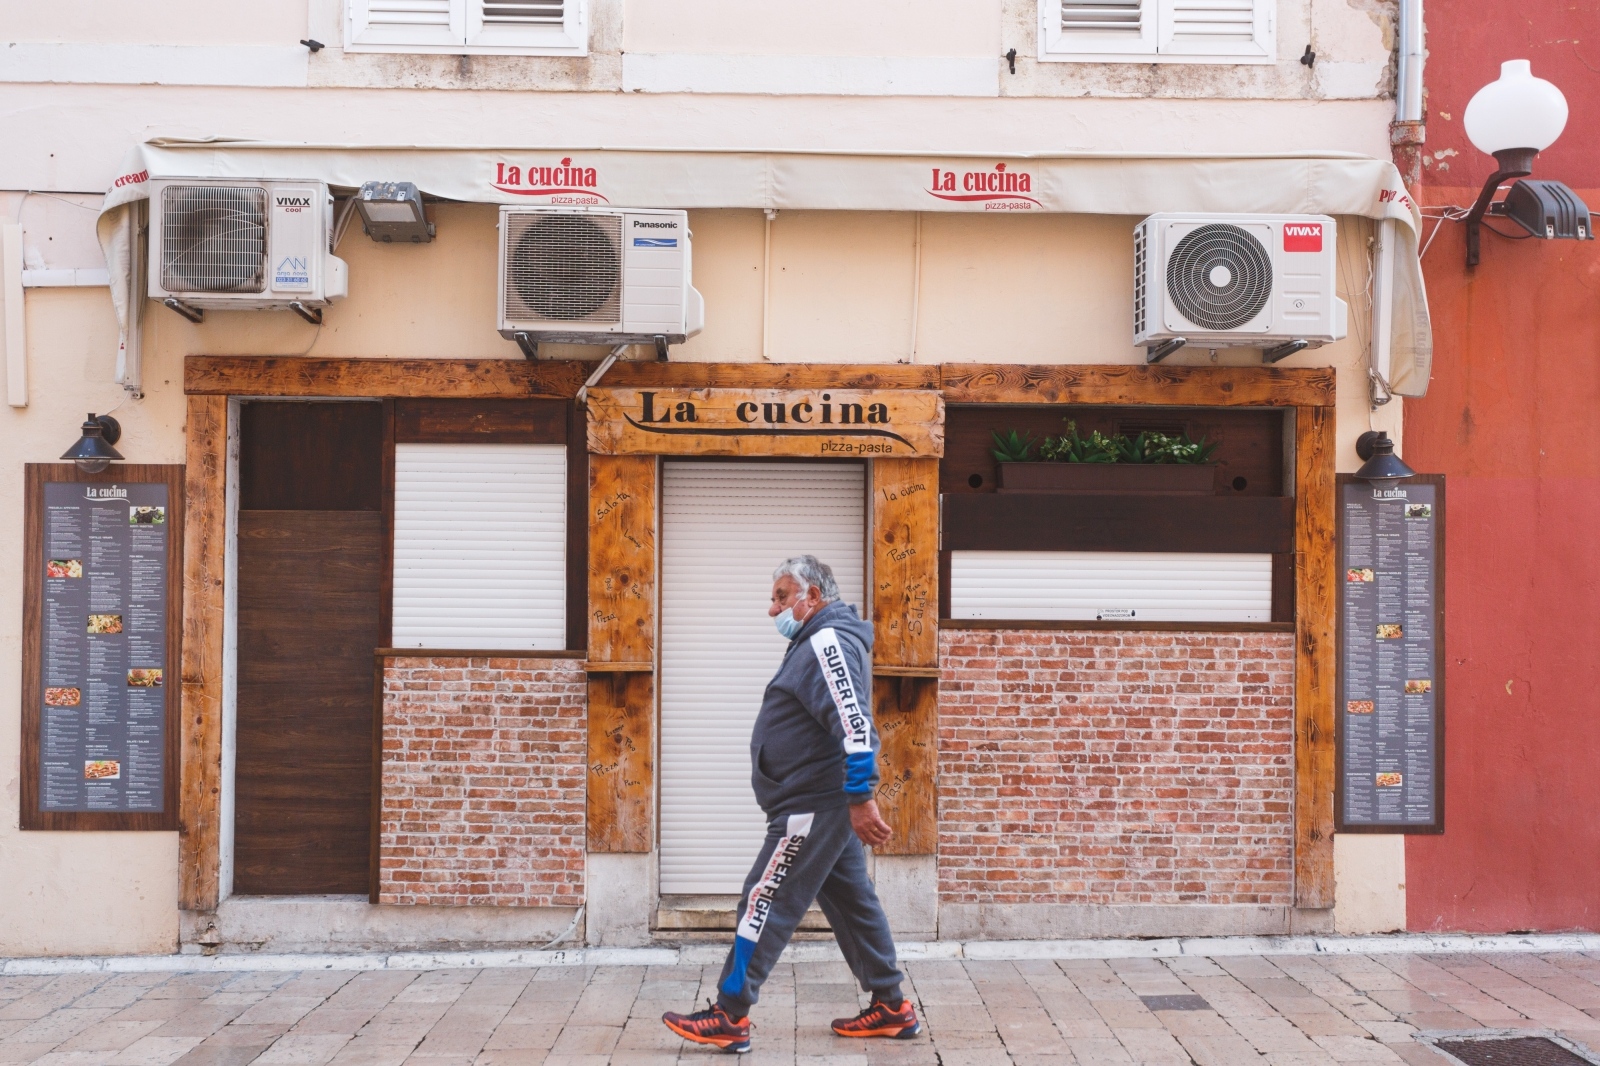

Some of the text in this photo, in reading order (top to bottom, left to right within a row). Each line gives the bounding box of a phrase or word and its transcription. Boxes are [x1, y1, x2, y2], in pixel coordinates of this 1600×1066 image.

[115, 169, 150, 188] cream
[496, 158, 598, 187] La cucina
[932, 163, 1031, 192] La cucina
[276, 197, 310, 206] VIVAX
[551, 195, 599, 205] pizza-pasta
[985, 201, 1031, 211] pizza-pasta
[633, 220, 678, 229] Panasonic
[1285, 226, 1321, 236] VIVAX
[638, 391, 892, 424] La cucina
[821, 441, 893, 454] pizza-pasta
[86, 485, 127, 498] La cucina
[900, 483, 926, 497] cucina
[1373, 487, 1407, 498] La cucina
[823, 644, 853, 701] SUPER
[749, 834, 806, 934] SUPER FIGHT
